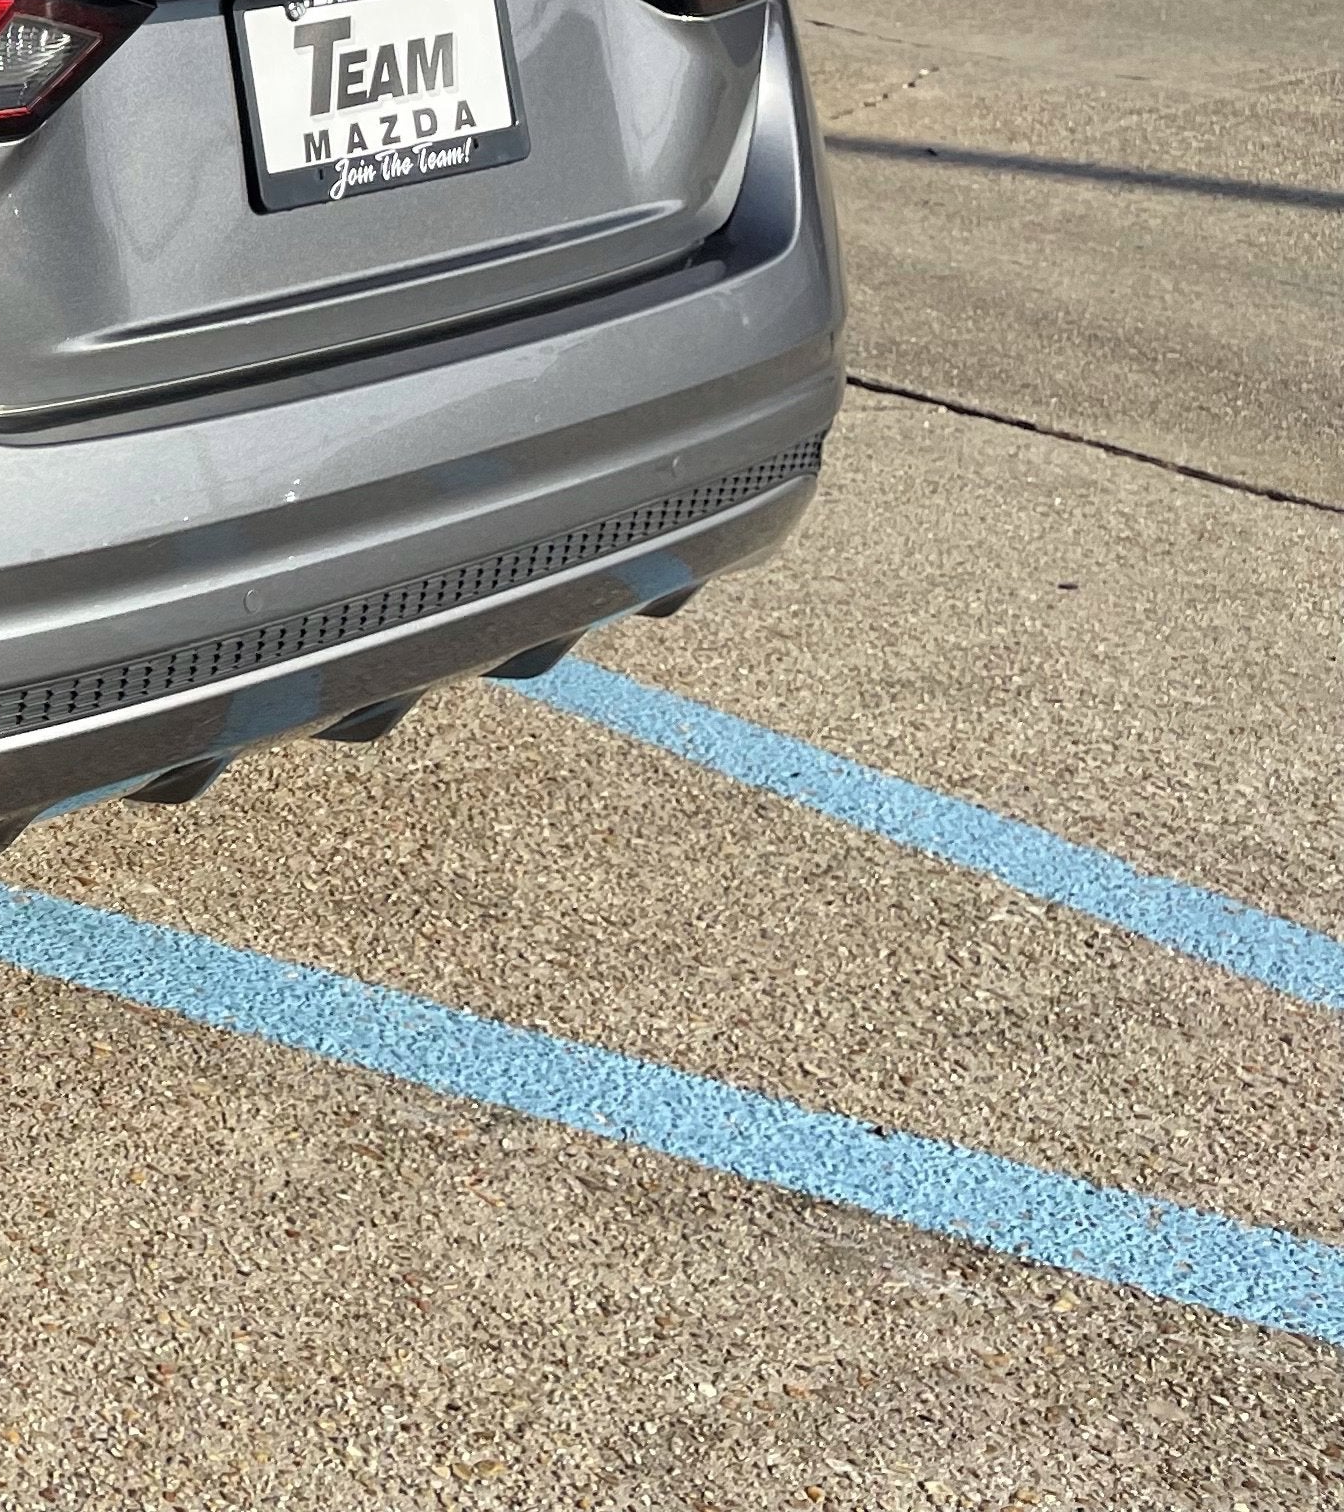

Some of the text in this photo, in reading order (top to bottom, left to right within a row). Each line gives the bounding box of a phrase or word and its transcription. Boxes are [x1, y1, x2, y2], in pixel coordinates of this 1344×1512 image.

[293, 16, 456, 118] TEAM
[304, 100, 476, 163] MAZDA
[330, 158, 376, 200] Join
